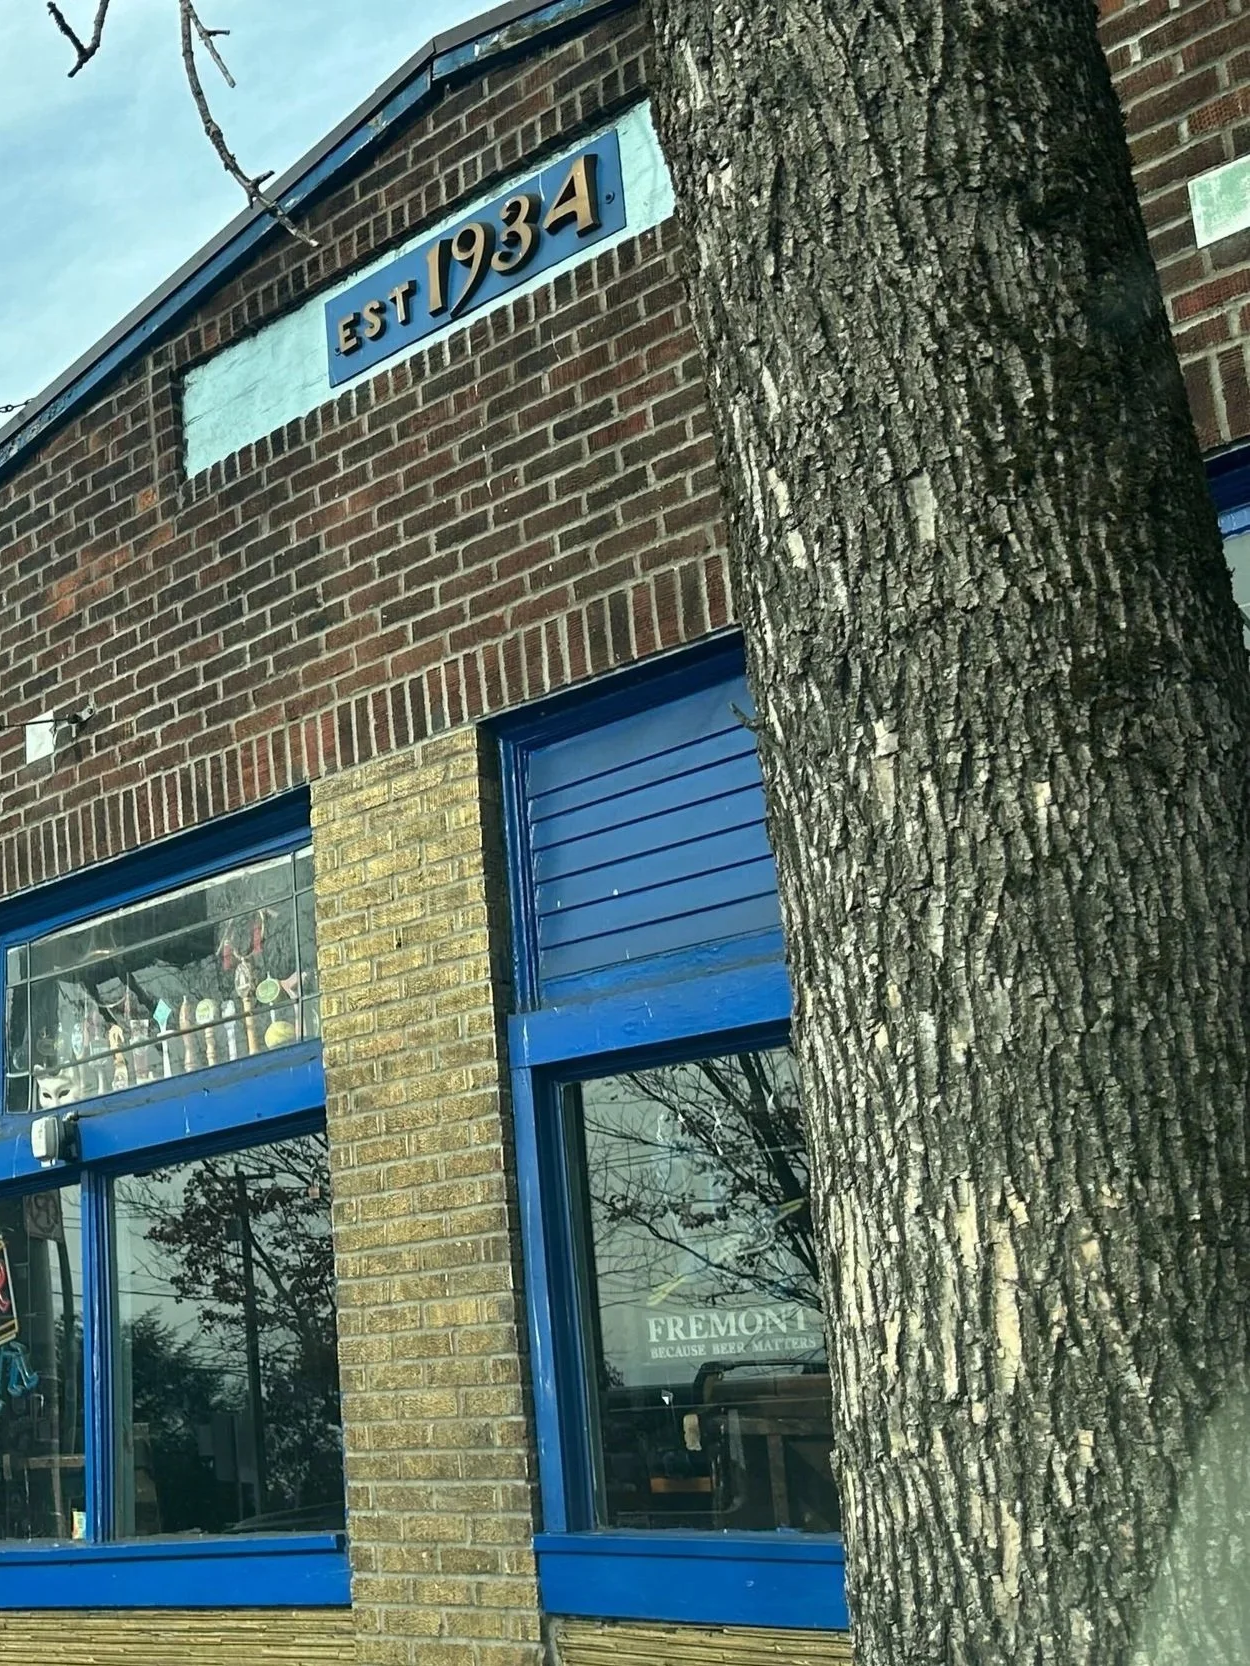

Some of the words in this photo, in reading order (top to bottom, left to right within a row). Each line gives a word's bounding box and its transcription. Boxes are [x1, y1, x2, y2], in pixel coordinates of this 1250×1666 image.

[337, 280, 415, 355] EST
[427, 154, 601, 319] 1934
[646, 1307, 810, 1343] FREMONT
[651, 1345, 707, 1360] BECAUSE
[712, 1342, 746, 1355] BEER
[751, 1337, 817, 1353] MATTERS
